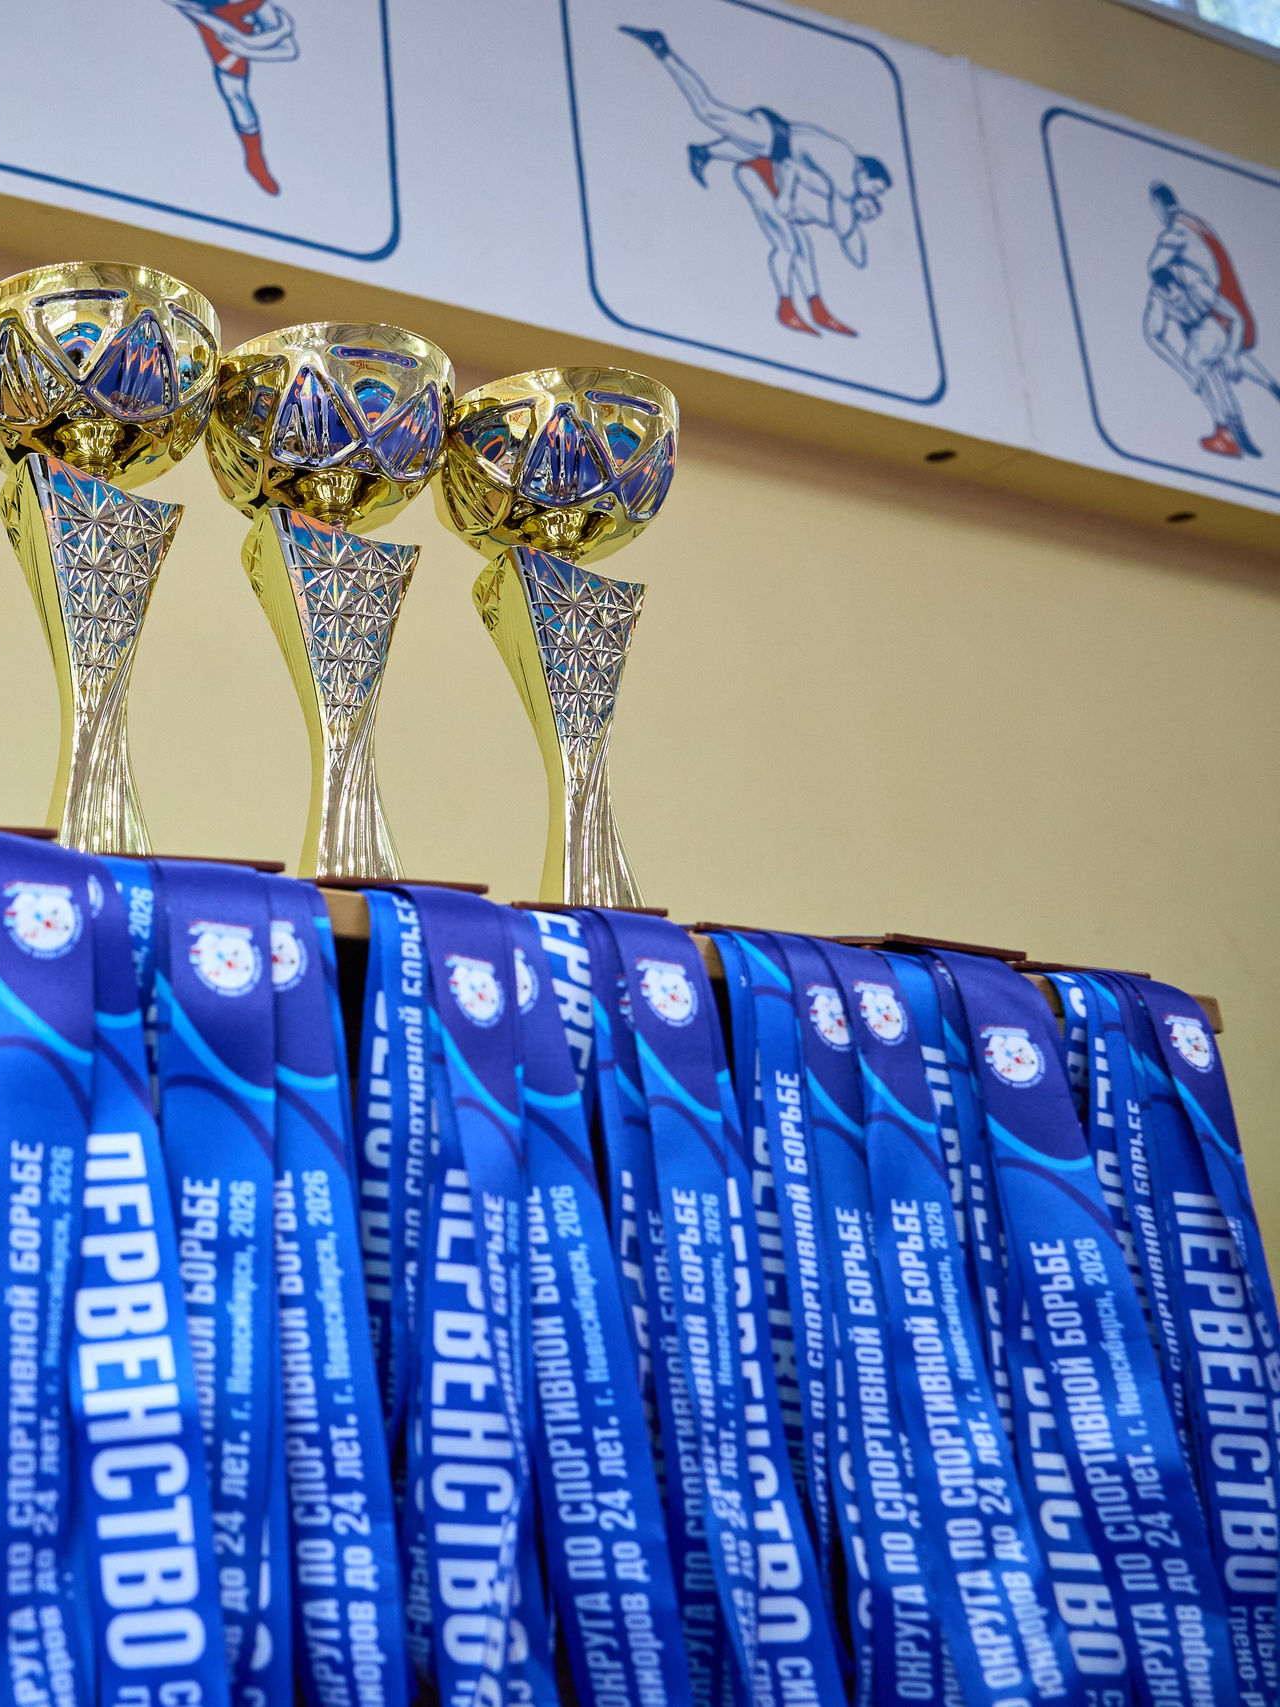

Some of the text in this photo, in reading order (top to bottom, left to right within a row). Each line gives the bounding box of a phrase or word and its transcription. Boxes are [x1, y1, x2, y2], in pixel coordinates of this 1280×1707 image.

[774, 1068, 810, 1176] БОРЬБЕ
[48, 1145, 75, 1205] 2026
[300, 1168, 334, 1228] 2026
[8, 1139, 45, 1273] БОРЬБЕ
[227, 1179, 258, 1240] 2026
[548, 1184, 583, 1239] 2026
[700, 1191, 723, 1247] 2026
[922, 1200, 950, 1251] 2026
[177, 1175, 221, 1306] БОРЬБЕ
[482, 1191, 510, 1319] БОРЬБЕ
[671, 1186, 708, 1306] БОРЬБЕ
[834, 1205, 878, 1318] БОРЬБЕ
[889, 1197, 936, 1308] БОРЬБЕ
[1072, 1236, 1110, 1287] 2026
[314, 1231, 353, 1381] Новосибирск,
[785, 1183, 826, 1371] СПОРТИВНОЙ
[1028, 1237, 1089, 1348] БОРЬБЕ
[1133, 1202, 1183, 1374] СПОРТИВНОЙ
[224, 1242, 261, 1396] Новосибирск,
[567, 1242, 612, 1384] Новосибирск,
[936, 1254, 978, 1382] Новосибирск,
[1094, 1289, 1144, 1417] Новосибирск,
[5, 1285, 41, 1530] СПОРТИВНОЙ
[74, 1131, 207, 1671] ПЕРВЕНСТВО
[229, 1400, 253, 1422] г.
[277, 1305, 333, 1527] СПОРТИВНОЙ
[331, 1384, 356, 1406] г.
[530, 1315, 599, 1525] СПОРТИВНОЙ
[593, 1386, 617, 1408] г.
[808, 1379, 827, 1421] ПО
[902, 1315, 980, 1509] СПОРТИВНОЙ
[965, 1385, 983, 1404] г.
[1171, 1190, 1280, 1594] ПЕРВЕНСТВО
[38, 1403, 62, 1477] лет.
[328, 1412, 365, 1483] лет.
[591, 1414, 630, 1480] лет.
[846, 1324, 909, 1522] СПОРТИВНОЙ
[967, 1410, 1004, 1469] лет.
[1048, 1355, 1144, 1544] СПОРТИВНОЙ
[1126, 1419, 1150, 1437] г.
[219, 1428, 252, 1501] лет.
[1125, 1444, 1168, 1502] лет.
[31, 1487, 61, 1538] 24
[329, 1489, 372, 1539] 24
[594, 1488, 638, 1532] 24
[975, 1474, 1014, 1517] 24
[211, 1508, 247, 1558] 24
[563, 1535, 608, 1581] ПО
[879, 1530, 920, 1575] ПО
[944, 1517, 989, 1562] ПО
[989, 1522, 1030, 1564] до
[1136, 1510, 1184, 1550] 24
[6, 1541, 36, 1597] ПО
[34, 1547, 62, 1597] до
[218, 1565, 251, 1615] до
[295, 1537, 338, 1588] ПО
[343, 1544, 380, 1593] до
[611, 1540, 653, 1584] до
[1114, 1551, 1162, 1593] ПО
[1160, 1557, 1202, 1597] до
[890, 1584, 935, 1701] ОКРУГА
[955, 1568, 1024, 1690] ОКРУГА
[1001, 1571, 1068, 1700] юниоров
